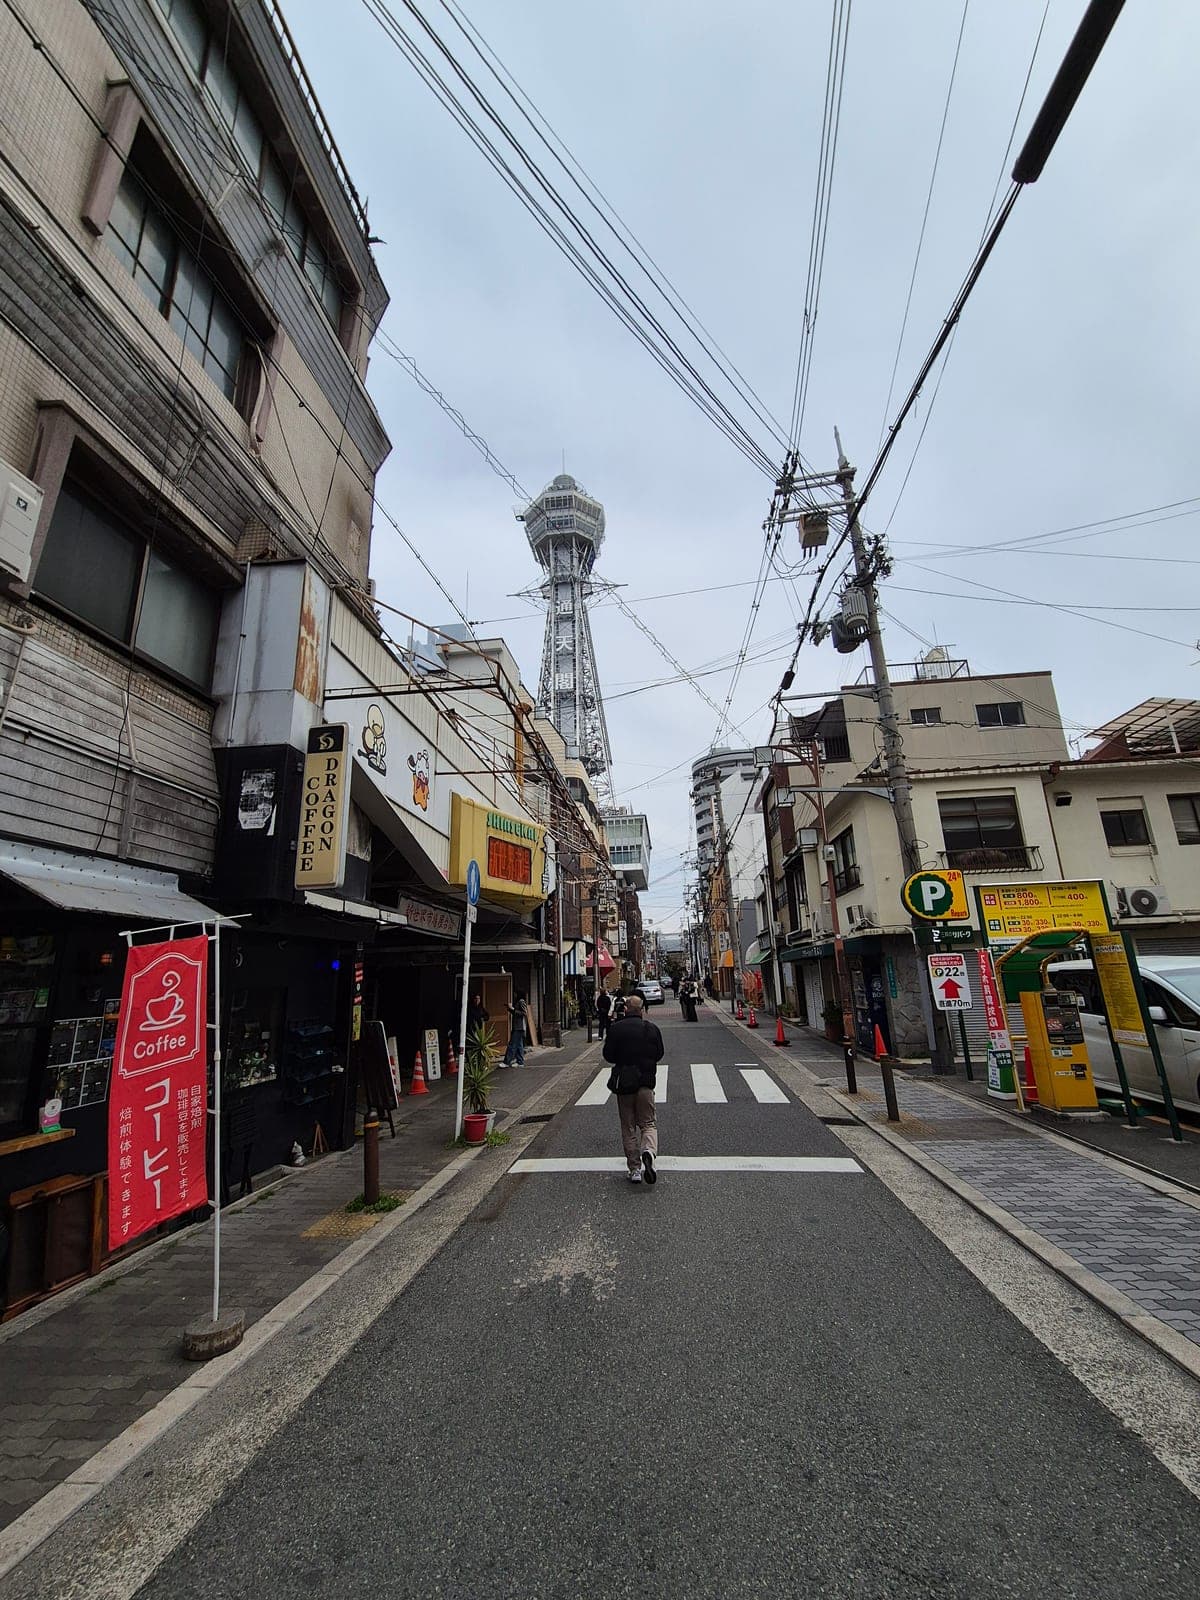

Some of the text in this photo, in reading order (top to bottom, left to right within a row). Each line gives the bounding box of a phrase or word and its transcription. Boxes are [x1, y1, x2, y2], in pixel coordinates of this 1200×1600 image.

[554, 600, 574, 690] 通天閣
[300, 777, 320, 872] COFFEE
[319, 757, 339, 851] DRAGON
[921, 881, 945, 911] P
[133, 1034, 187, 1059] Coffee
[143, 1077, 171, 1210] コーヒー
[190, 1085, 202, 1130] 自家焙煎
[119, 1107, 133, 1236] 焙煎体験できます
